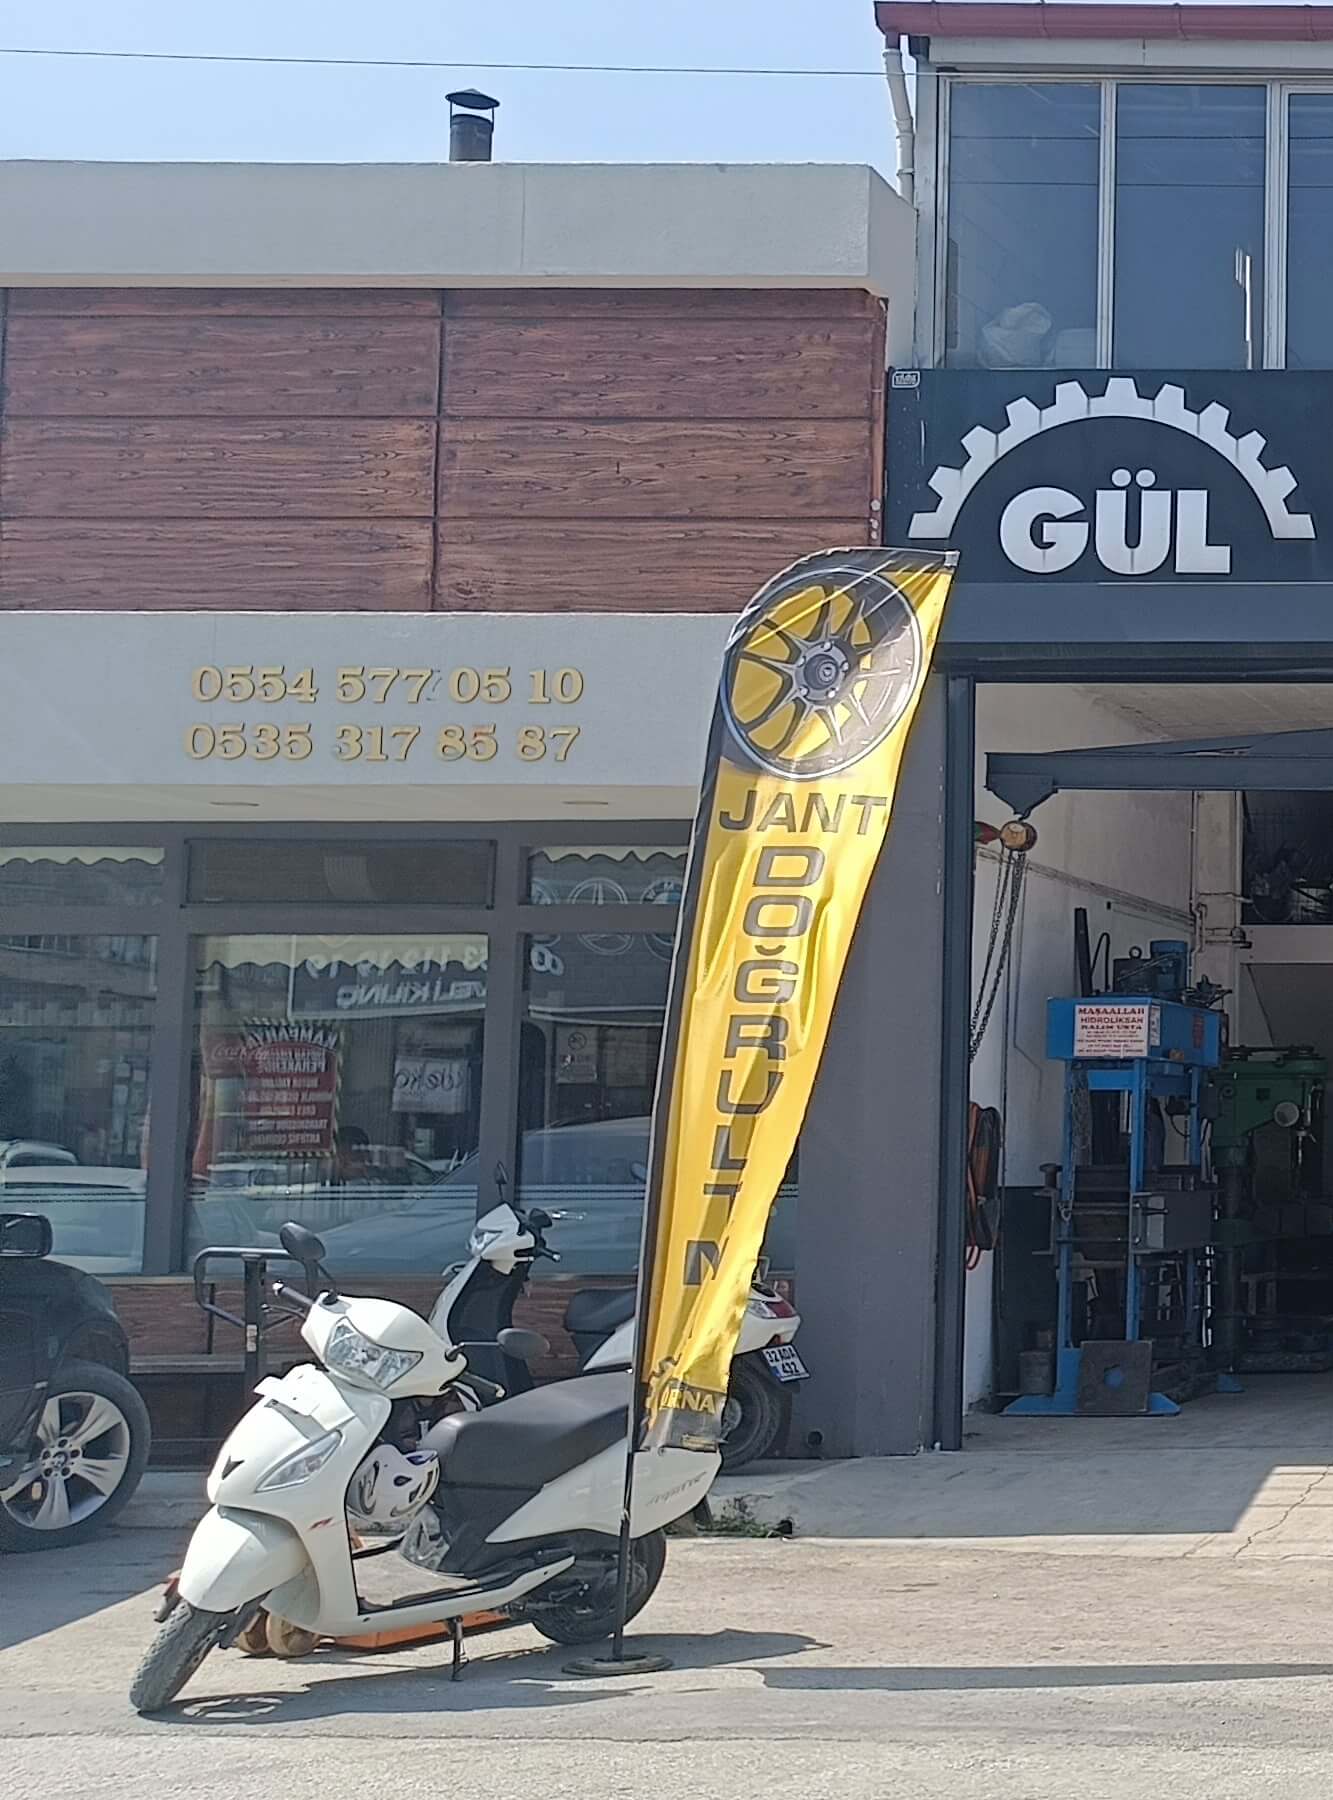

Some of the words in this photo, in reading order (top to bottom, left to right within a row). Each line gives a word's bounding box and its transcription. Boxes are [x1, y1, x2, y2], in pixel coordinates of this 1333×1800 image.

[999, 468, 1232, 575] GÜL
[192, 665, 320, 704] 0554
[335, 666, 434, 705] 577
[448, 667, 513, 705] 05
[528, 668, 584, 705] 10
[184, 723, 313, 761] 0535
[335, 724, 421, 762] 317
[437, 724, 499, 762] 85
[517, 725, 581, 762] 87
[719, 789, 888, 836] JANT
